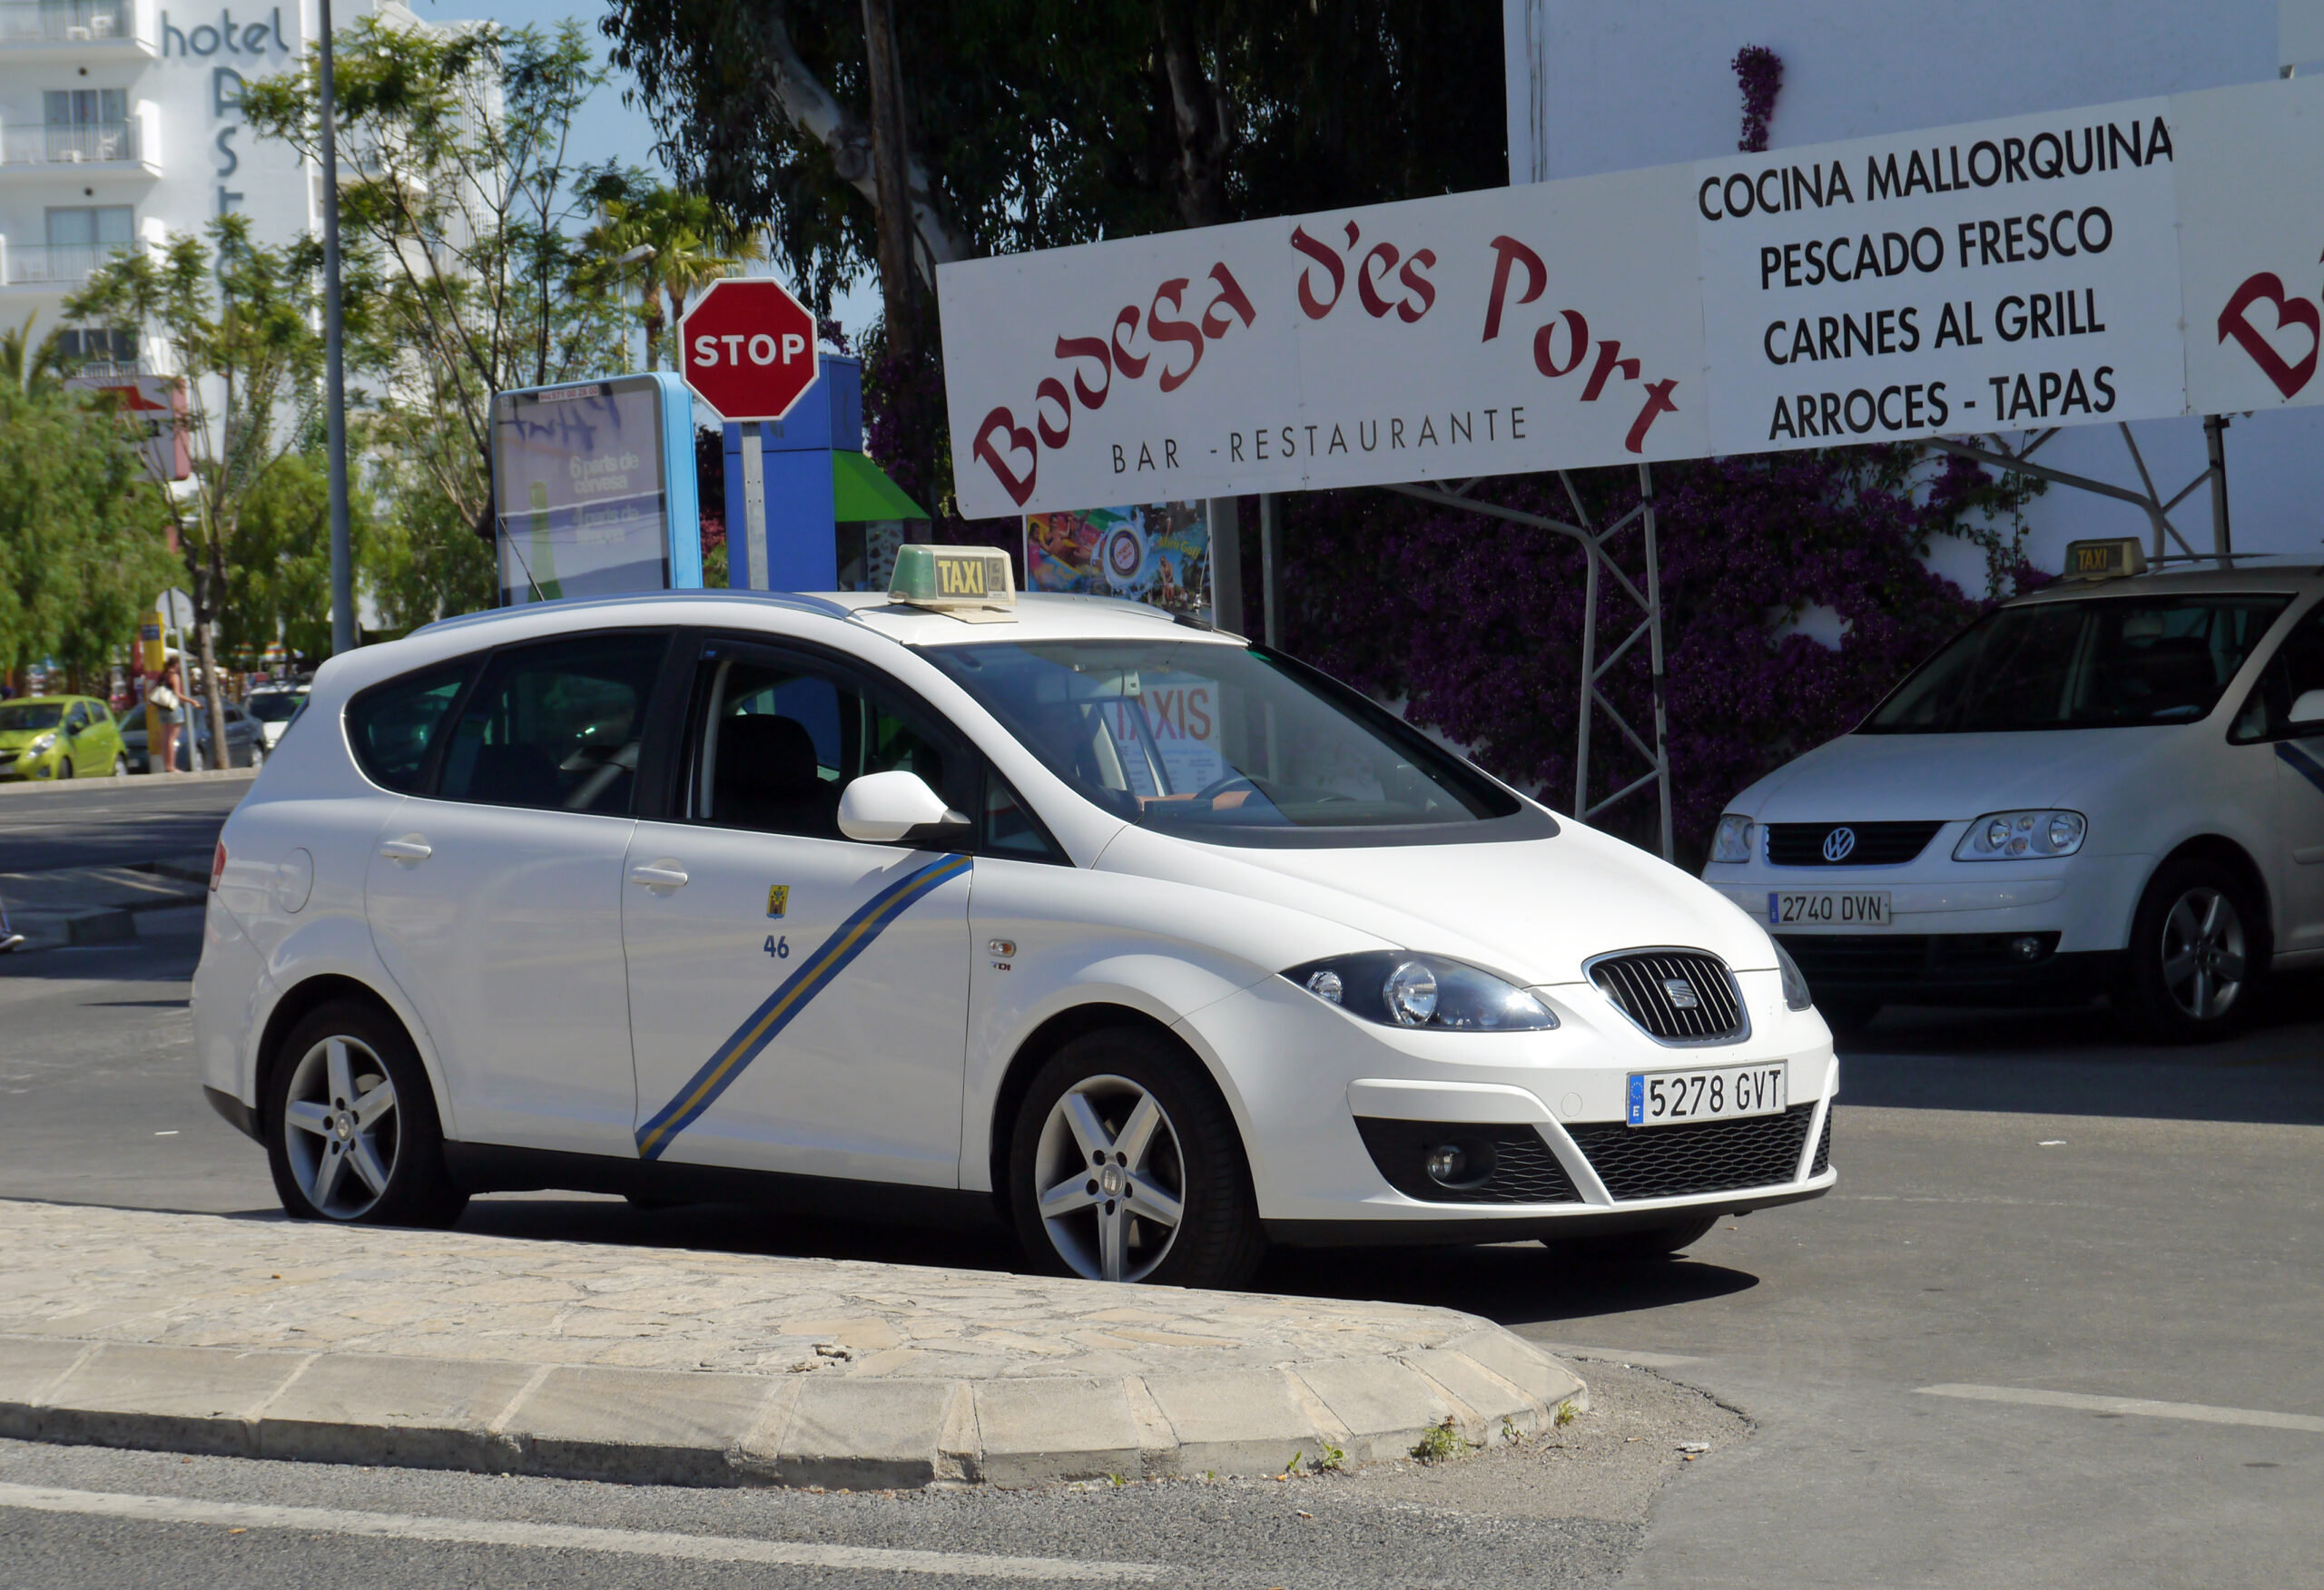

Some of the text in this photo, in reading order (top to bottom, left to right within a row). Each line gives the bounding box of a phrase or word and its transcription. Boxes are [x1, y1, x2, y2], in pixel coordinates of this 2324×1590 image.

[162, 6, 290, 56] hotel
[1699, 116, 2173, 221] COCINA MALLORQUINA
[1760, 206, 2113, 290] PESCADO FRESCO
[1764, 288, 2106, 366] CARNES AL GRILL
[694, 333, 805, 368] STOP
[972, 220, 1679, 508] Bodega d'es Port
[1768, 381, 1949, 441] ARROCES
[1988, 366, 2116, 421] TAPAS
[569, 455, 582, 479] 6
[1112, 438, 1179, 474] BAR
[1180, 541, 1203, 560] Golf
[2077, 548, 2107, 571] TAXI
[938, 560, 984, 594] TAXI
[1782, 896, 1833, 922] 2740
[1842, 895, 1881, 921] DVN
[763, 935, 790, 959] 46
[1632, 1069, 1781, 1117] E 5278 GVT
